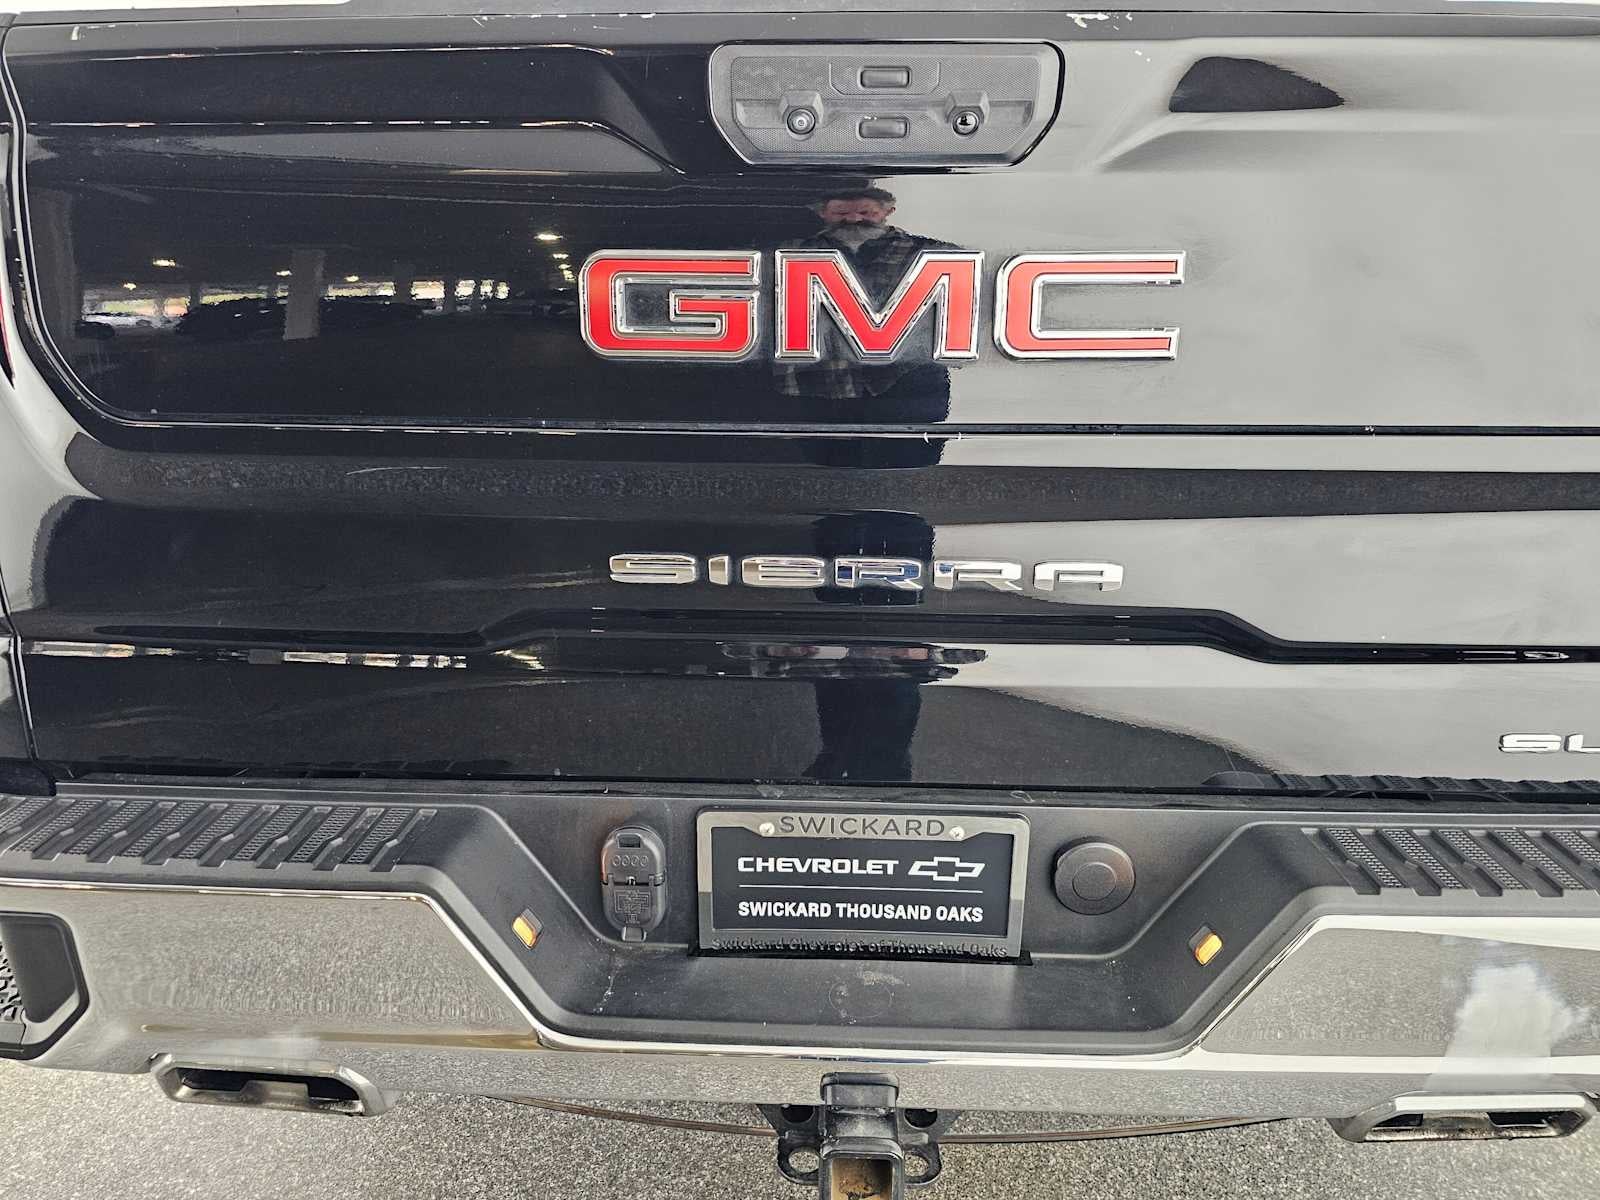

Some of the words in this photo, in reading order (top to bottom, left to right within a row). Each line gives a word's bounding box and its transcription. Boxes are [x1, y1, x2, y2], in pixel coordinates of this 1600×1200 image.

[578, 250, 1186, 361] GMC
[608, 553, 1125, 592] SIERRA
[779, 815, 946, 838] SWICKARD
[737, 856, 899, 876] CHEVROLET
[737, 901, 832, 918] SWICKARD
[835, 903, 931, 921] THOUSAND
[935, 906, 984, 922] OAKS
[711, 937, 784, 951] Swickard
[868, 940, 886, 953] of
[969, 944, 1009, 958] Oaks
